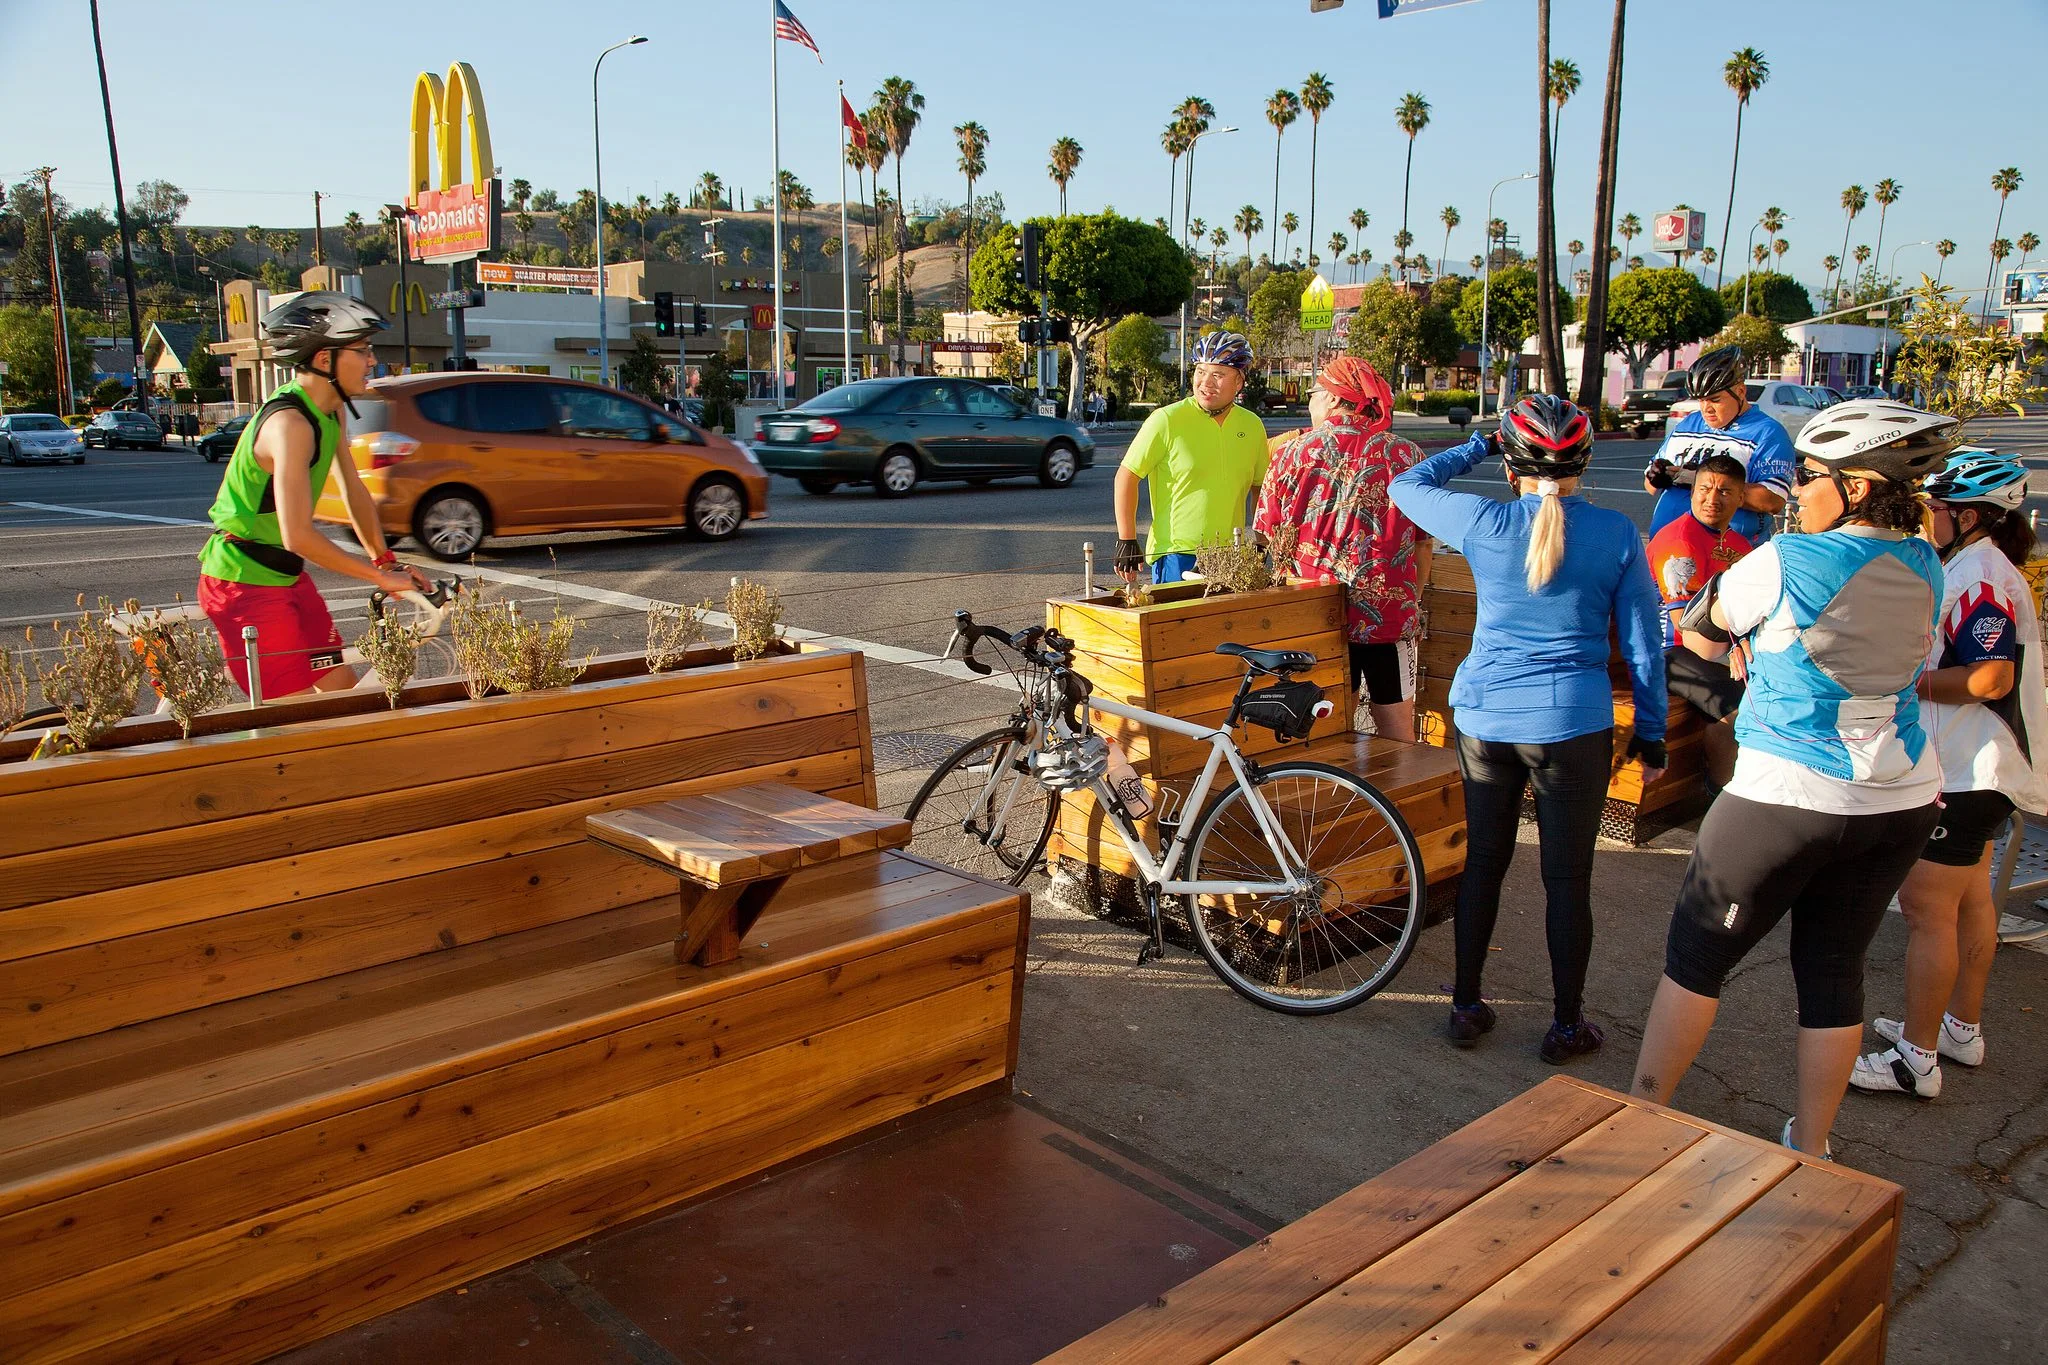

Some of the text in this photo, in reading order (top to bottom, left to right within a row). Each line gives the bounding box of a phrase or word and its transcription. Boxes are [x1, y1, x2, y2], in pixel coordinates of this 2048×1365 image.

[409, 203, 486, 235] McDonald's
[1655, 217, 1684, 238] Jack
[483, 268, 507, 279] new
[514, 271, 546, 281] QUARTER
[547, 272, 580, 282] POUNDER
[720, 277, 800, 294] PLAYPLCE
[1303, 315, 1330, 325] AHEAD
[947, 344, 987, 352] DRIVE-THRU
[1040, 406, 1054, 415] ONE
[1868, 429, 1901, 446] GIRO
[1961, 1024, 1975, 1032] Tri
